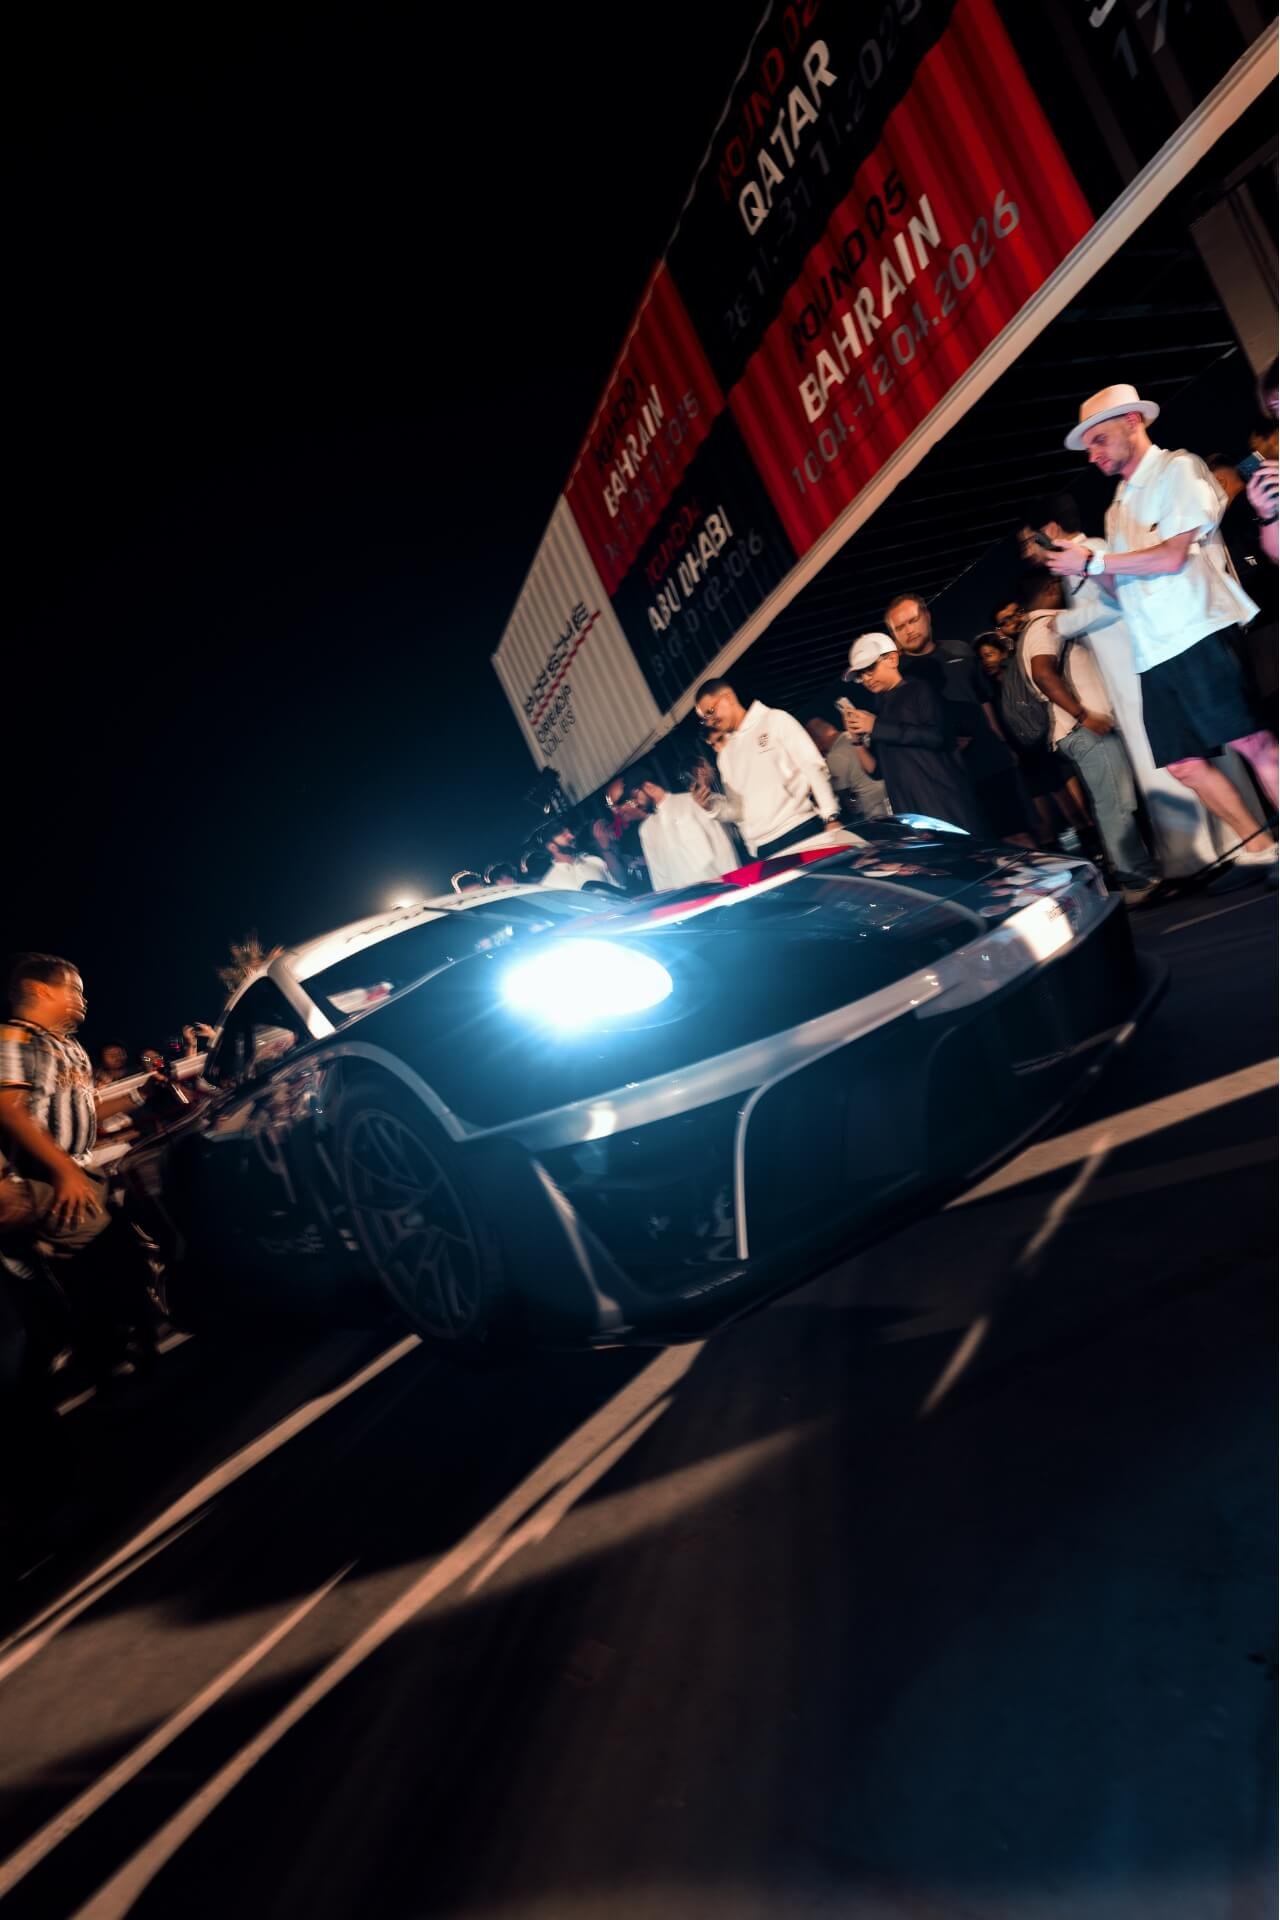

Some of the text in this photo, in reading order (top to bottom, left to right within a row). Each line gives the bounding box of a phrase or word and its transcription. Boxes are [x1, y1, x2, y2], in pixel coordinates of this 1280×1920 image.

[738, 38, 838, 237] QATAR
[798, 192, 942, 424] BAHRAIN
[601, 383, 665, 519] BAHRAIN
[646, 577, 682, 633] ABU
[676, 503, 735, 598] DHABI
